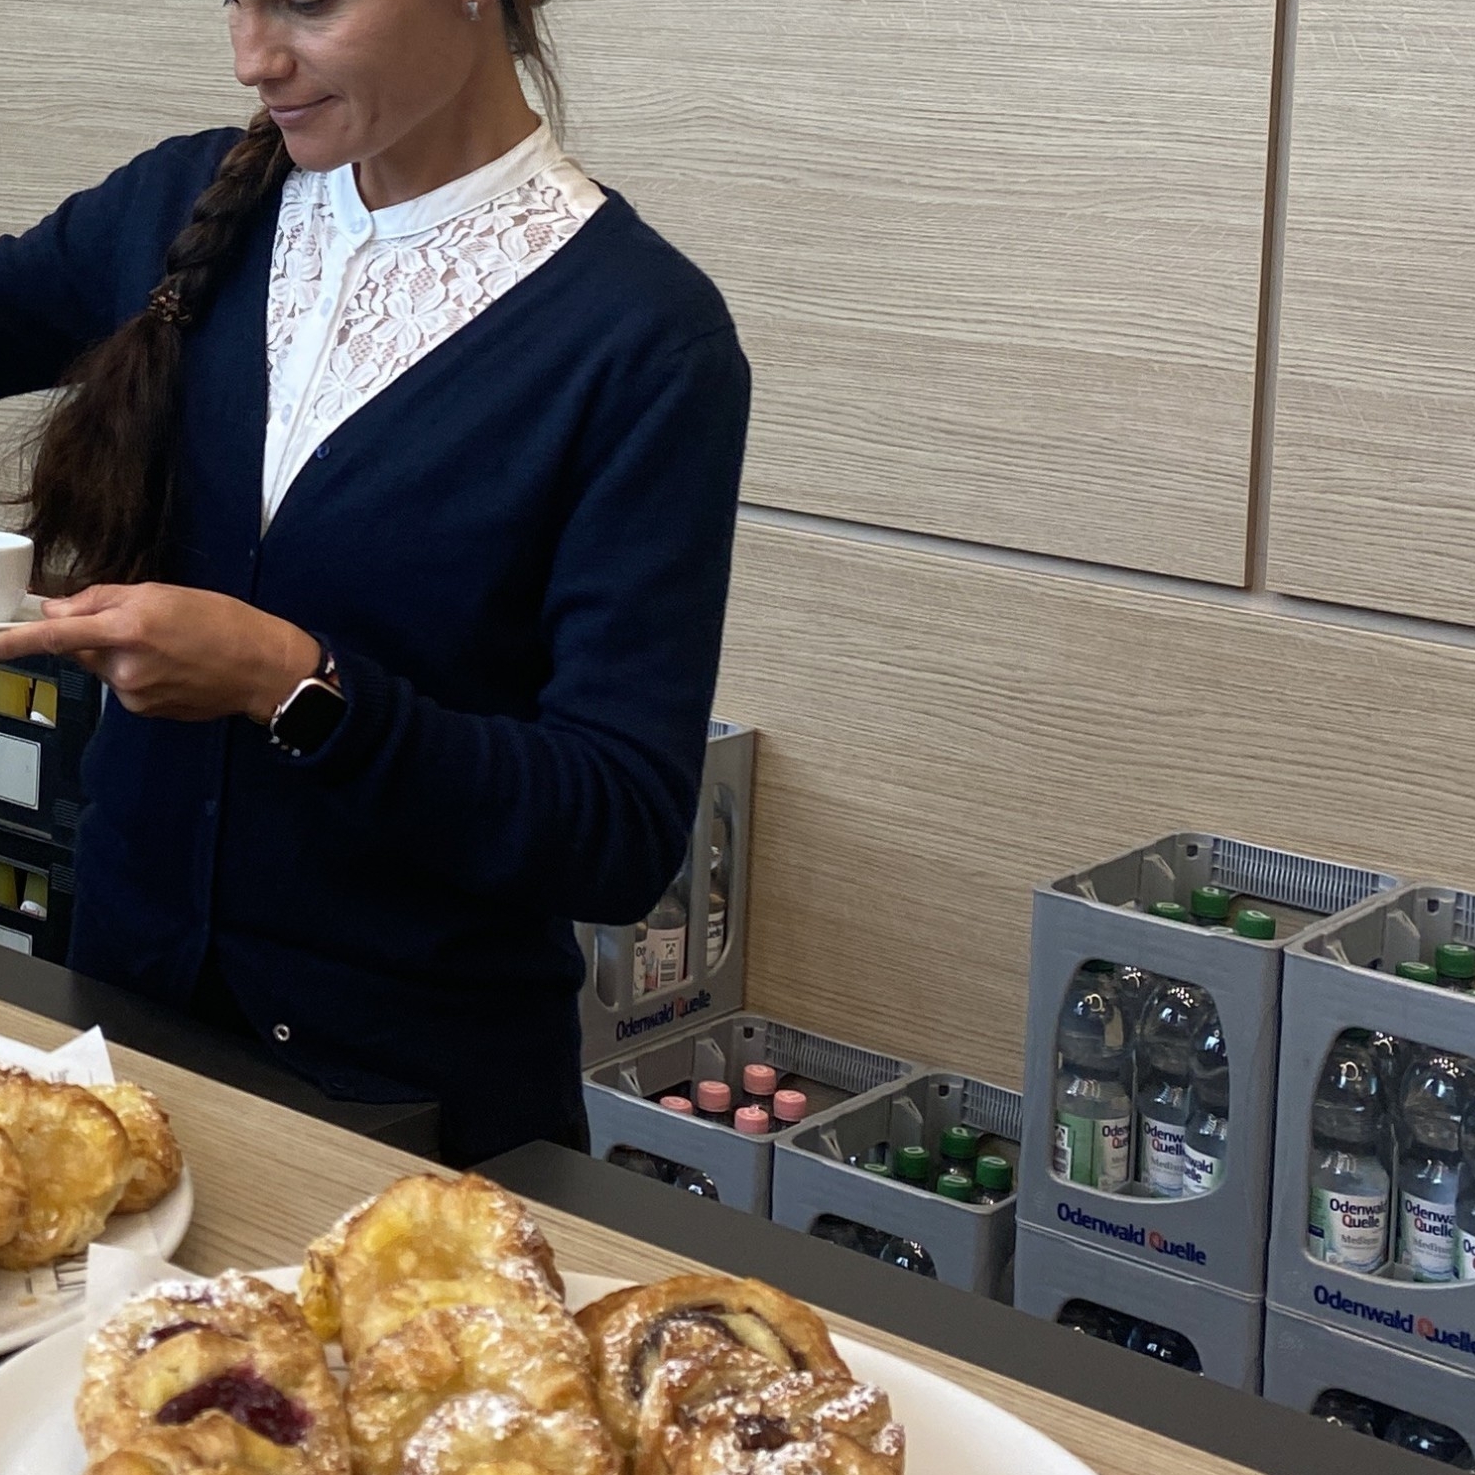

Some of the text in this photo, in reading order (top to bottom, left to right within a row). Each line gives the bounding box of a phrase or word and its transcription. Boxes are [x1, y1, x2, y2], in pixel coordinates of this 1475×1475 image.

[616, 1000, 674, 1041] Odenwald
[1144, 1122, 1184, 1144] Odenw
[1057, 1202, 1207, 1265] Odenwald Quelle
[1342, 1214, 1380, 1228] Quelle
[1314, 1285, 1414, 1334] Odenwald
